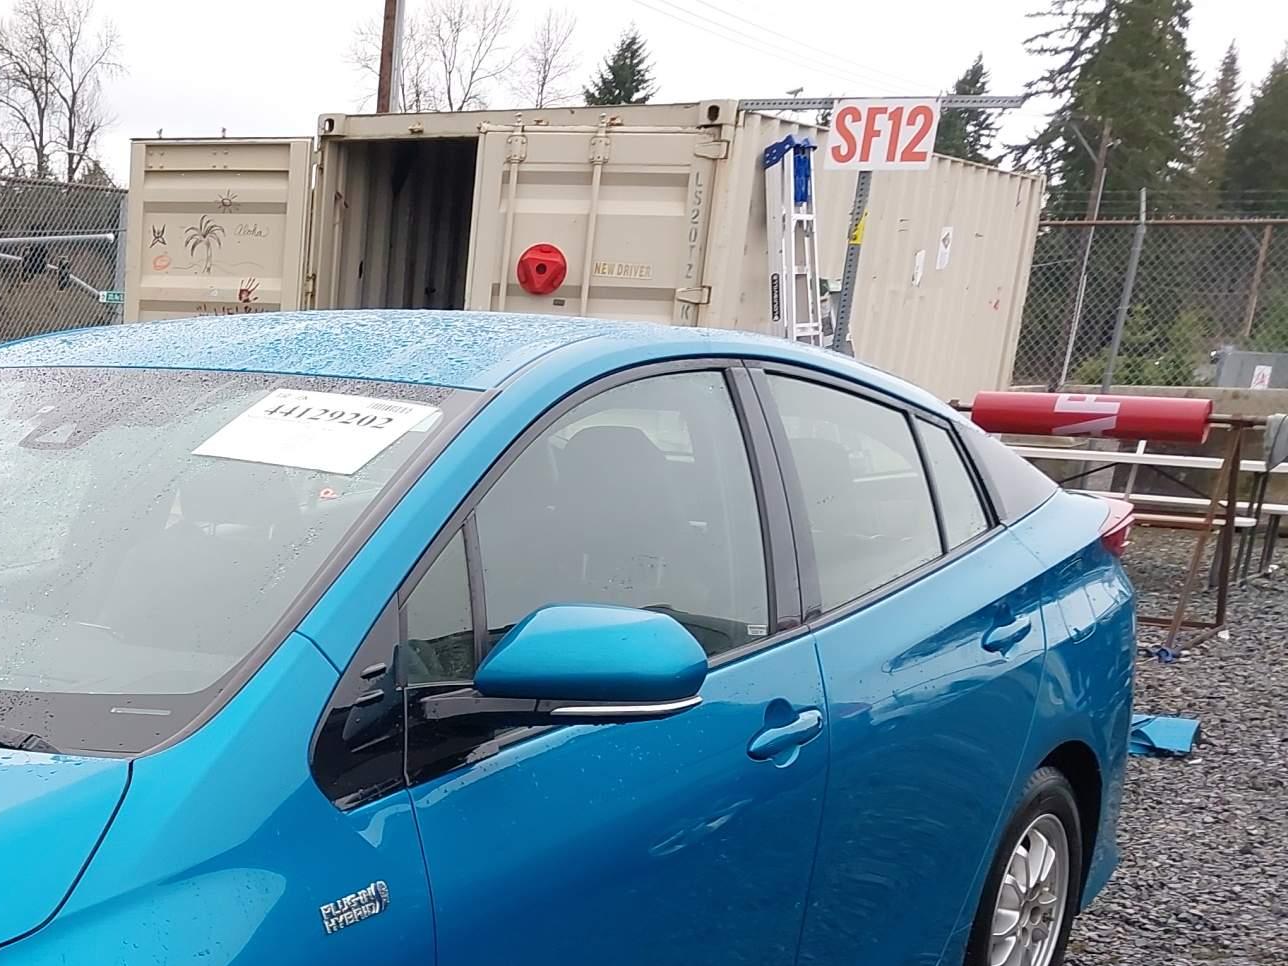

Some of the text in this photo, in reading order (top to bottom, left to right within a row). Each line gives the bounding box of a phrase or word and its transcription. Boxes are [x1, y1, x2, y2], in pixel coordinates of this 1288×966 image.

[831, 105, 934, 163] SF12
[594, 261, 652, 278] NEW DRIVER
[264, 403, 394, 429] 44129202
[323, 901, 380, 934] HYBRID
